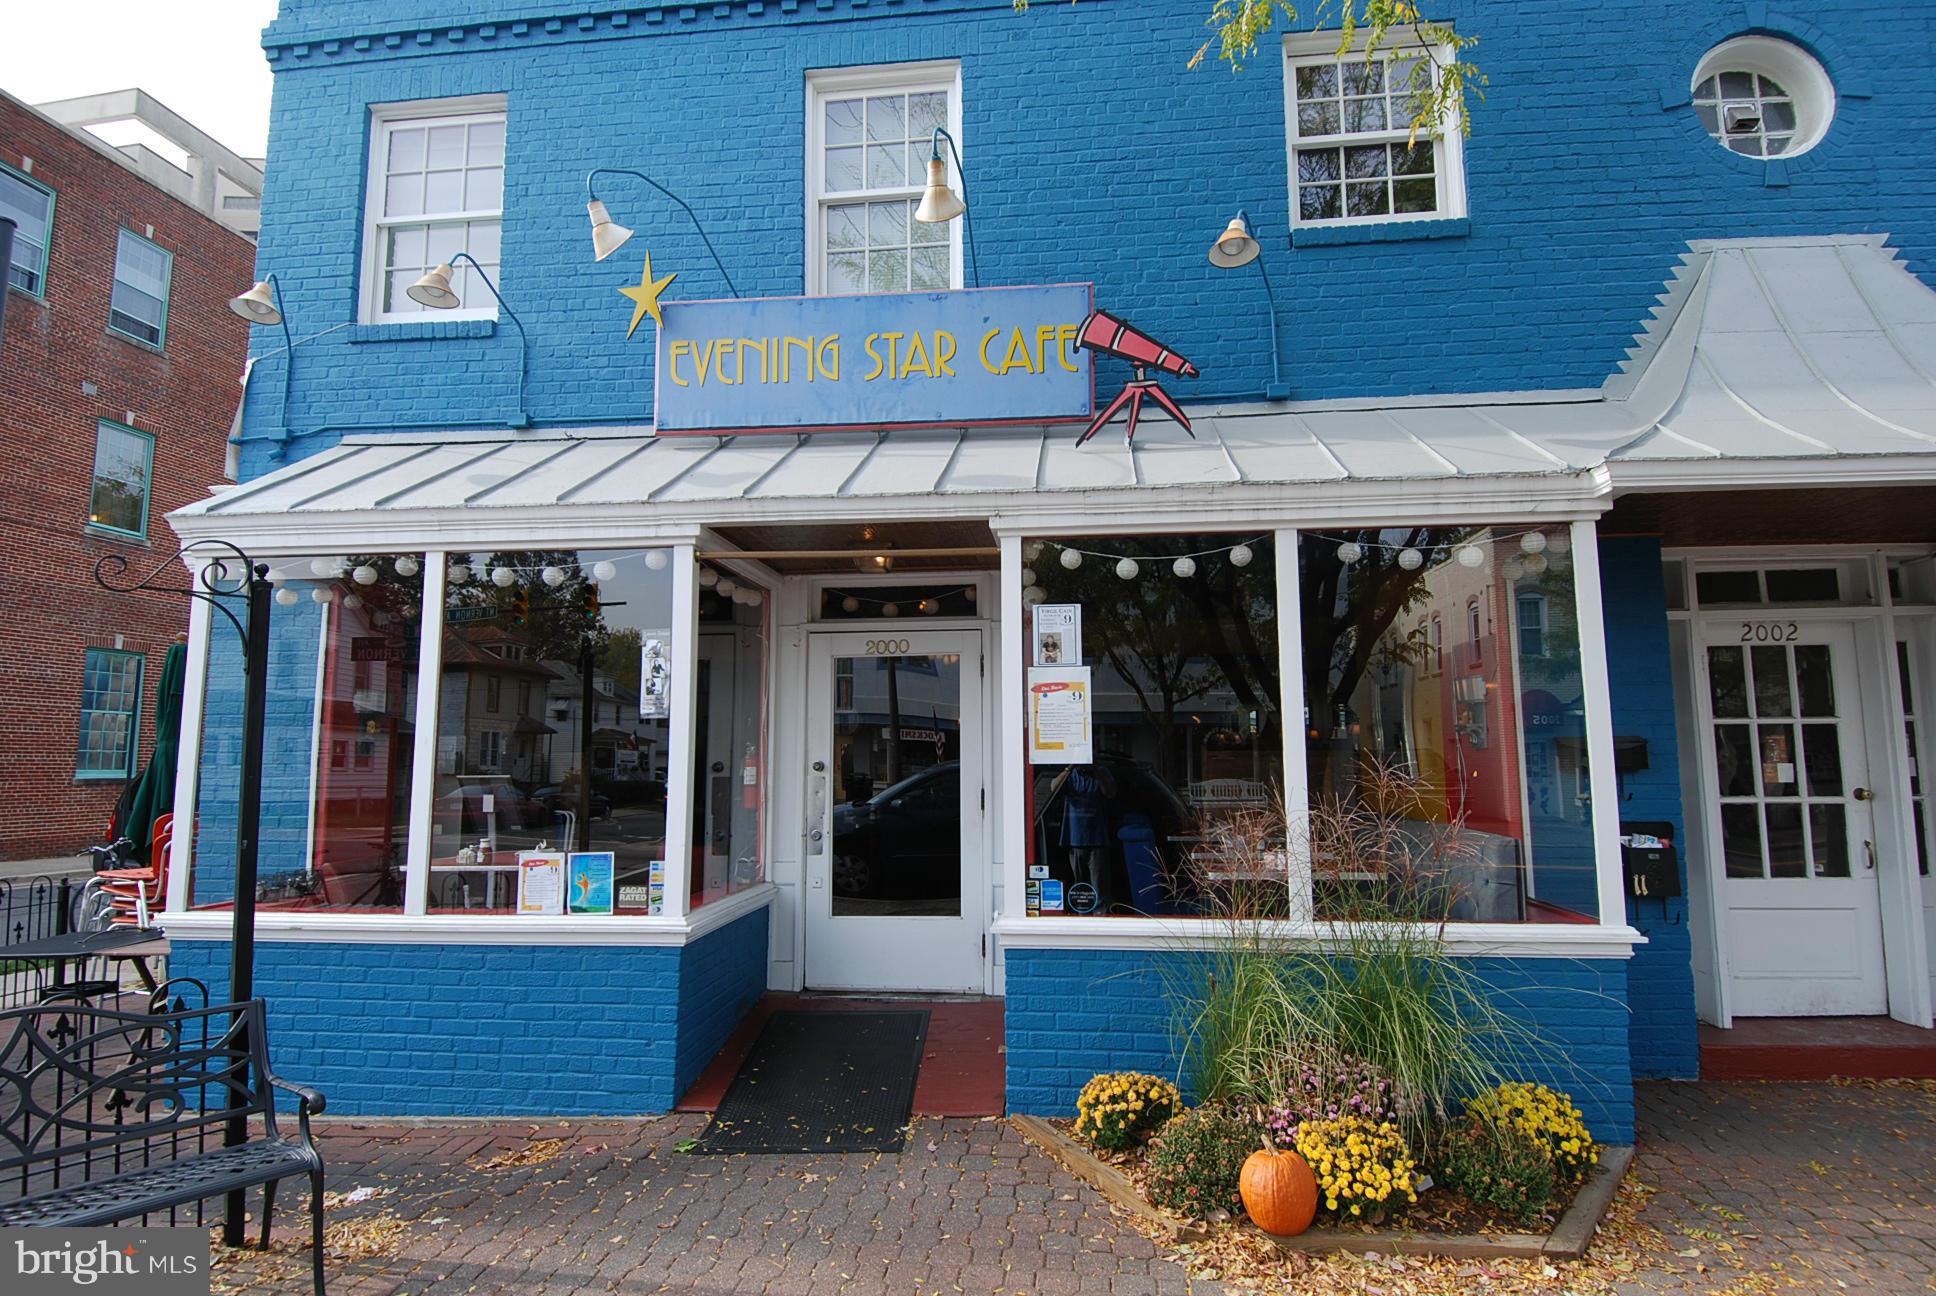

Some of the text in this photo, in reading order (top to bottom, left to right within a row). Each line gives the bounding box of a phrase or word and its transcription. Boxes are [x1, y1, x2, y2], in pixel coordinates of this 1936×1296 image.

[670, 324, 1080, 388] EVENING STAR CAFE
[1741, 623, 1798, 641] 2002
[865, 639, 910, 655] 2000
[618, 893, 647, 902] RATED
[619, 886, 647, 894] ZAGAT
